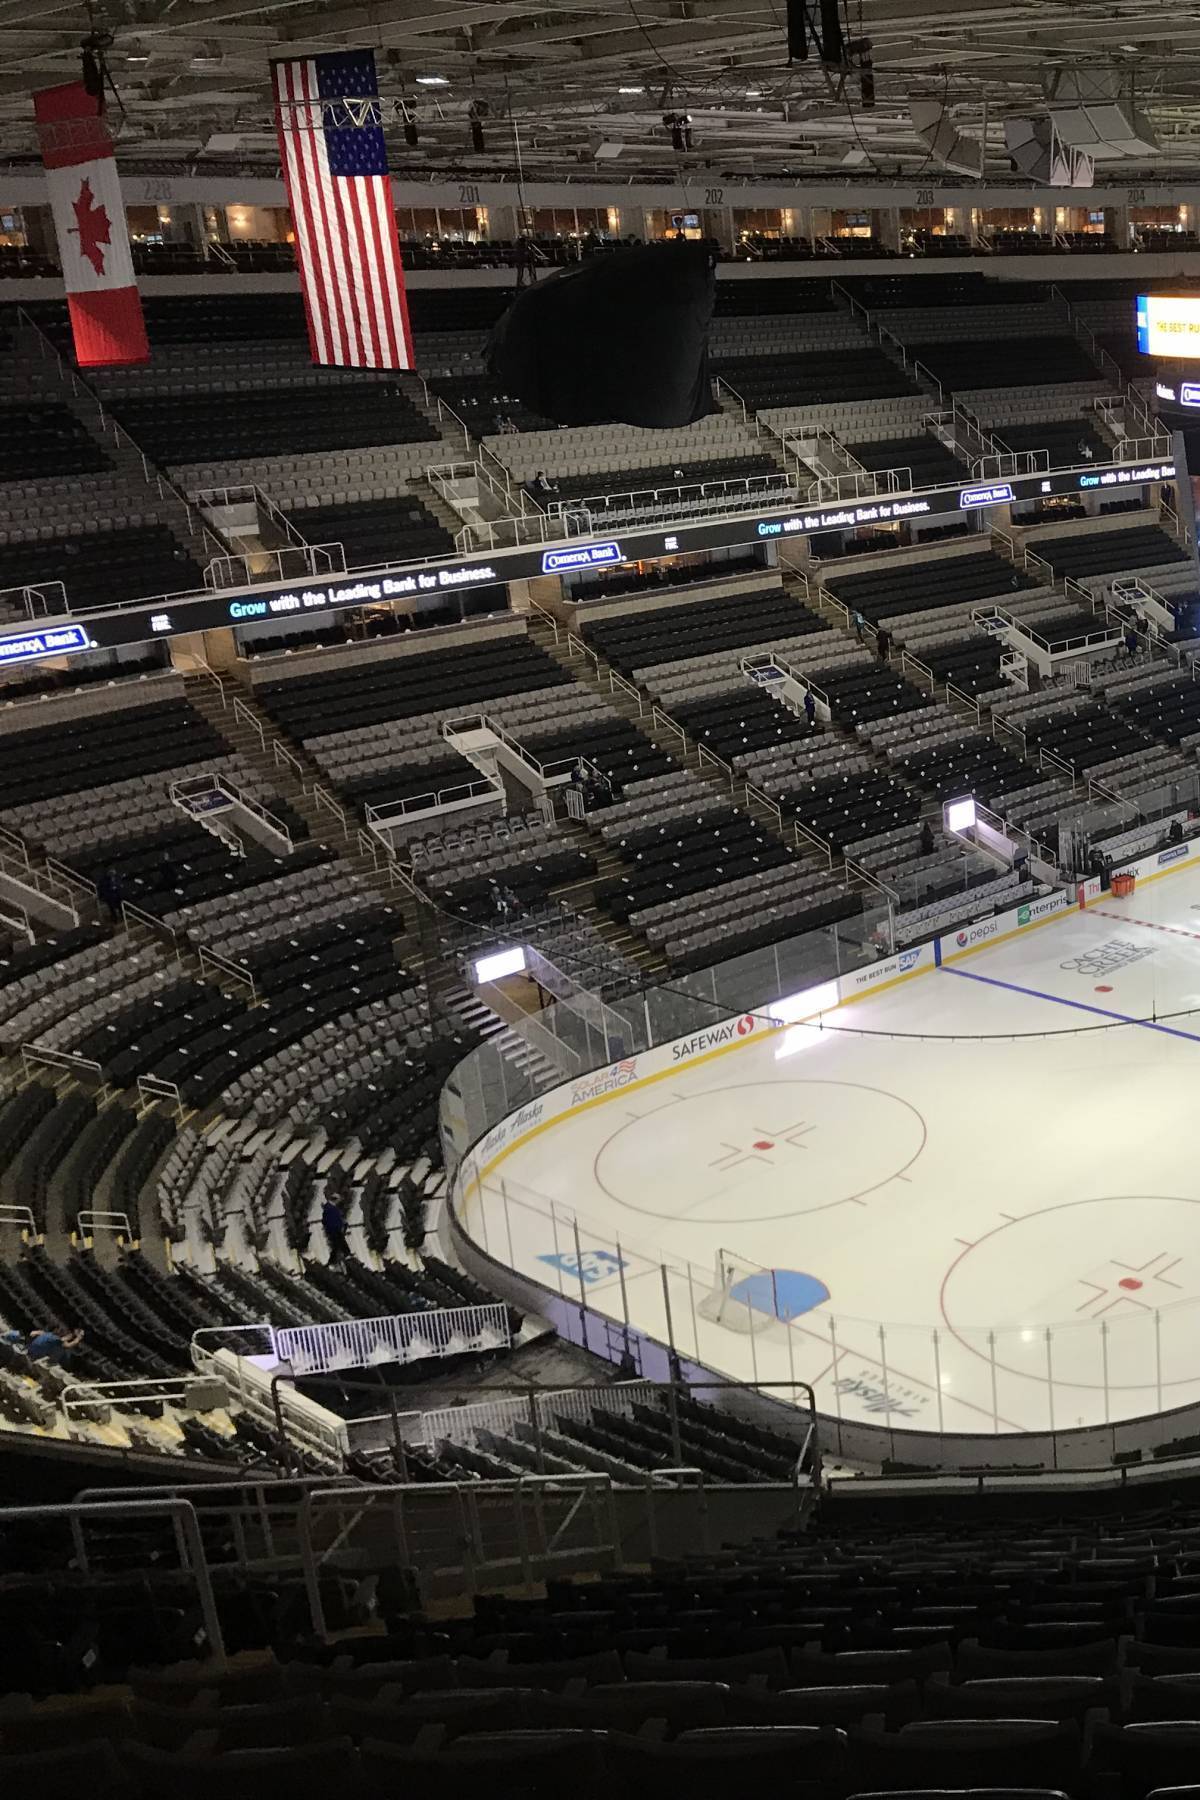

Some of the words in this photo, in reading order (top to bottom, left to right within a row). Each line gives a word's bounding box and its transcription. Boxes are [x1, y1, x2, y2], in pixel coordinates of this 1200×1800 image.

[459, 185, 480, 203] 201
[705, 188, 724, 205] 202
[916, 190, 934, 206] 203
[1128, 190, 1145, 203] 204
[1080, 476, 1099, 487] Grow
[1100, 472, 1117, 484] with
[1118, 471, 1130, 482] the
[1132, 468, 1160, 480] Leading
[1162, 466, 1176, 476] Ban
[758, 522, 782, 536] Grow
[784, 519, 802, 532] with
[804, 516, 820, 528] the
[821, 512, 855, 526] Leading
[856, 507, 878, 520] Bank
[880, 506, 891, 516] for
[893, 501, 930, 515] Business.
[592, 546, 614, 558] Bank
[230, 601, 266, 618] Grow
[270, 596, 300, 612] with
[302, 591, 326, 606] the
[328, 583, 381, 602] Leading
[383, 576, 416, 594] Bank
[418, 574, 436, 589] for
[439, 568, 496, 586] Business.
[44, 631, 80, 648] Bank
[970, 922, 998, 944] pepsi
[1060, 939, 1132, 970] CACHE
[1077, 945, 1148, 976] CREEK
[856, 975, 867, 984] THE
[869, 969, 883, 979] BEST
[884, 964, 897, 973] RUN
[672, 1024, 735, 1061] SAFEWAY
[570, 1072, 609, 1091] SOLAR
[610, 1066, 618, 1077] 4
[571, 1072, 638, 1106] AMERICA
[481, 1127, 506, 1154] Alaska
[511, 1103, 544, 1130] Alaska
[831, 1378, 920, 1417] Alaska
